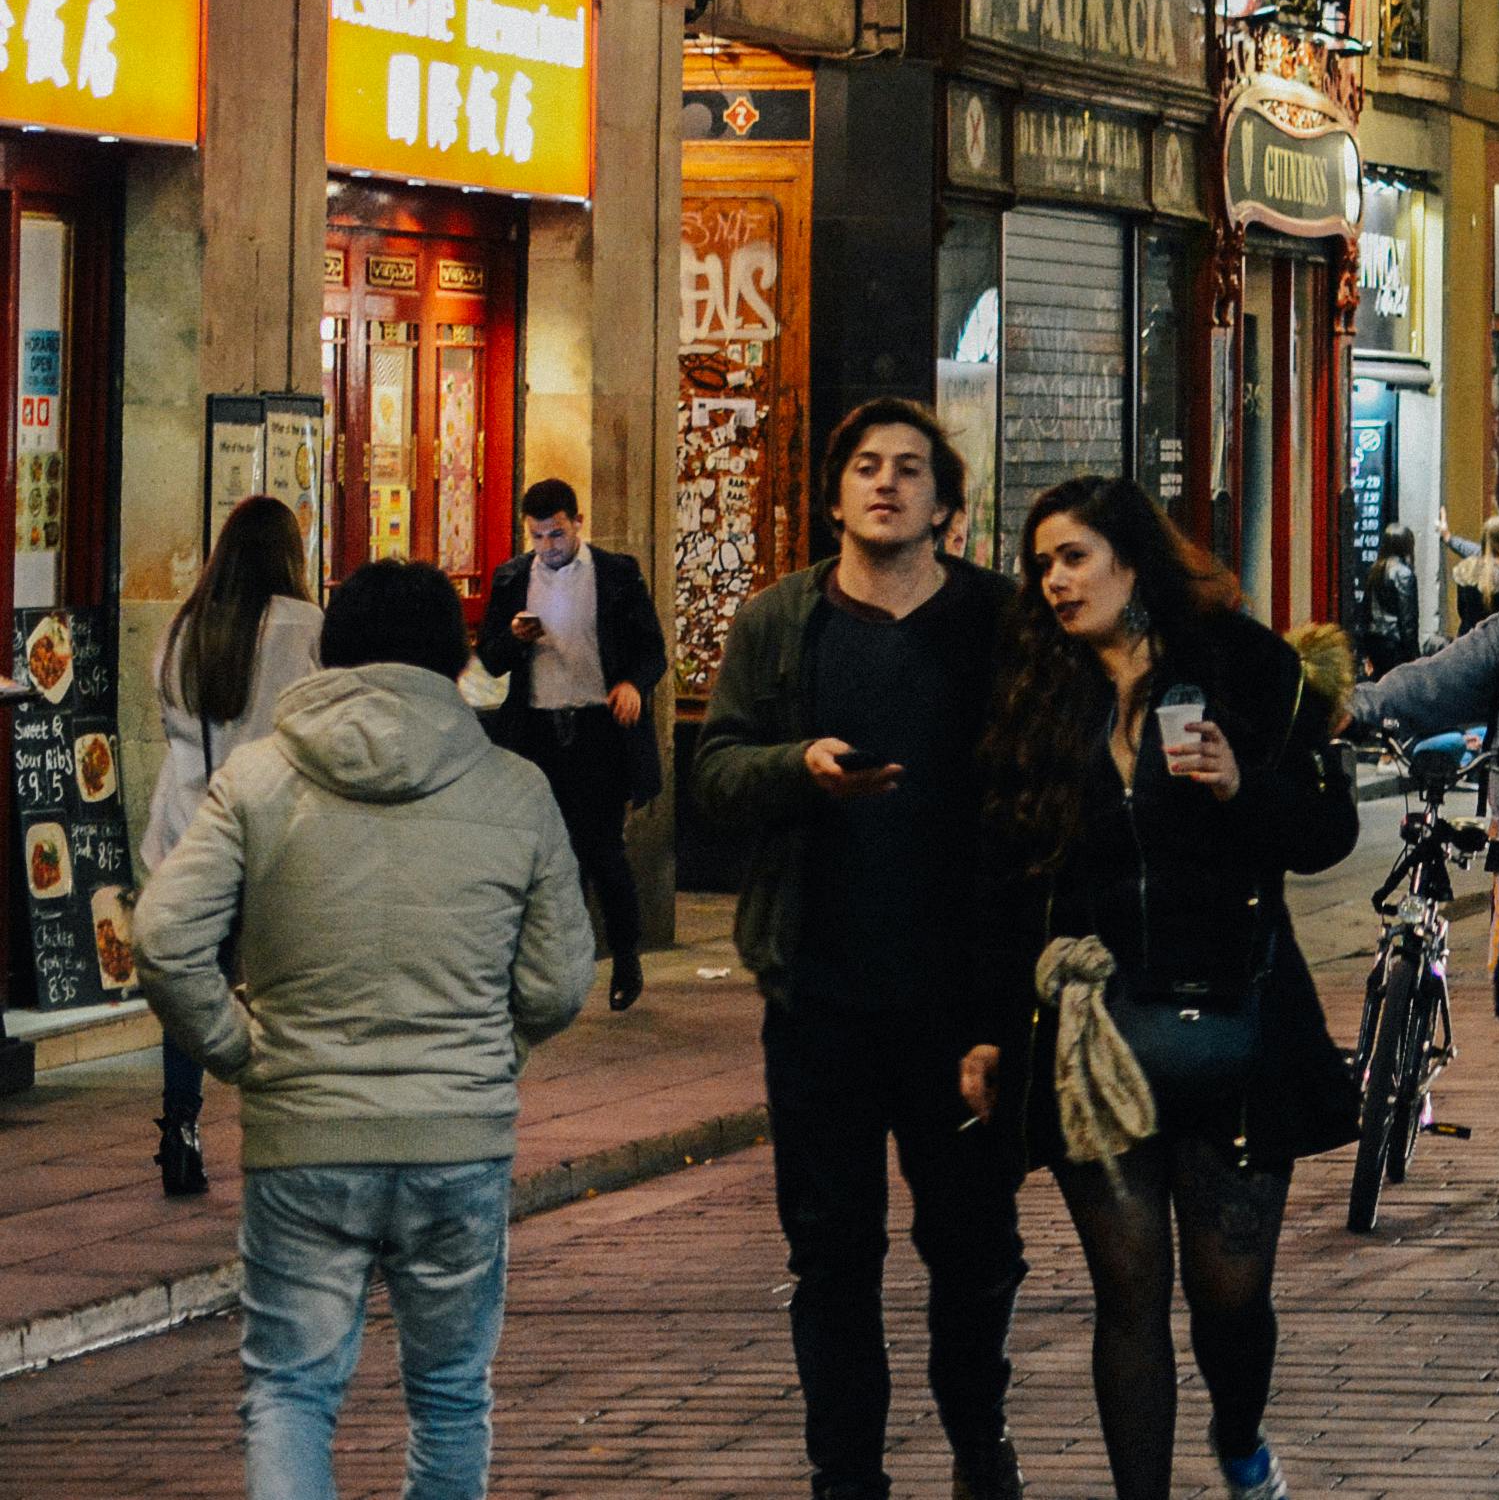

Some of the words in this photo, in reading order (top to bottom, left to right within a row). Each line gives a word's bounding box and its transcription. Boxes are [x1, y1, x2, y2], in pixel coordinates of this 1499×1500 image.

[1264, 145, 1328, 207] GUINNESS
[14, 720, 49, 741] Sweet
[15, 750, 41, 771] Sour
[45, 749, 74, 775] Ribs
